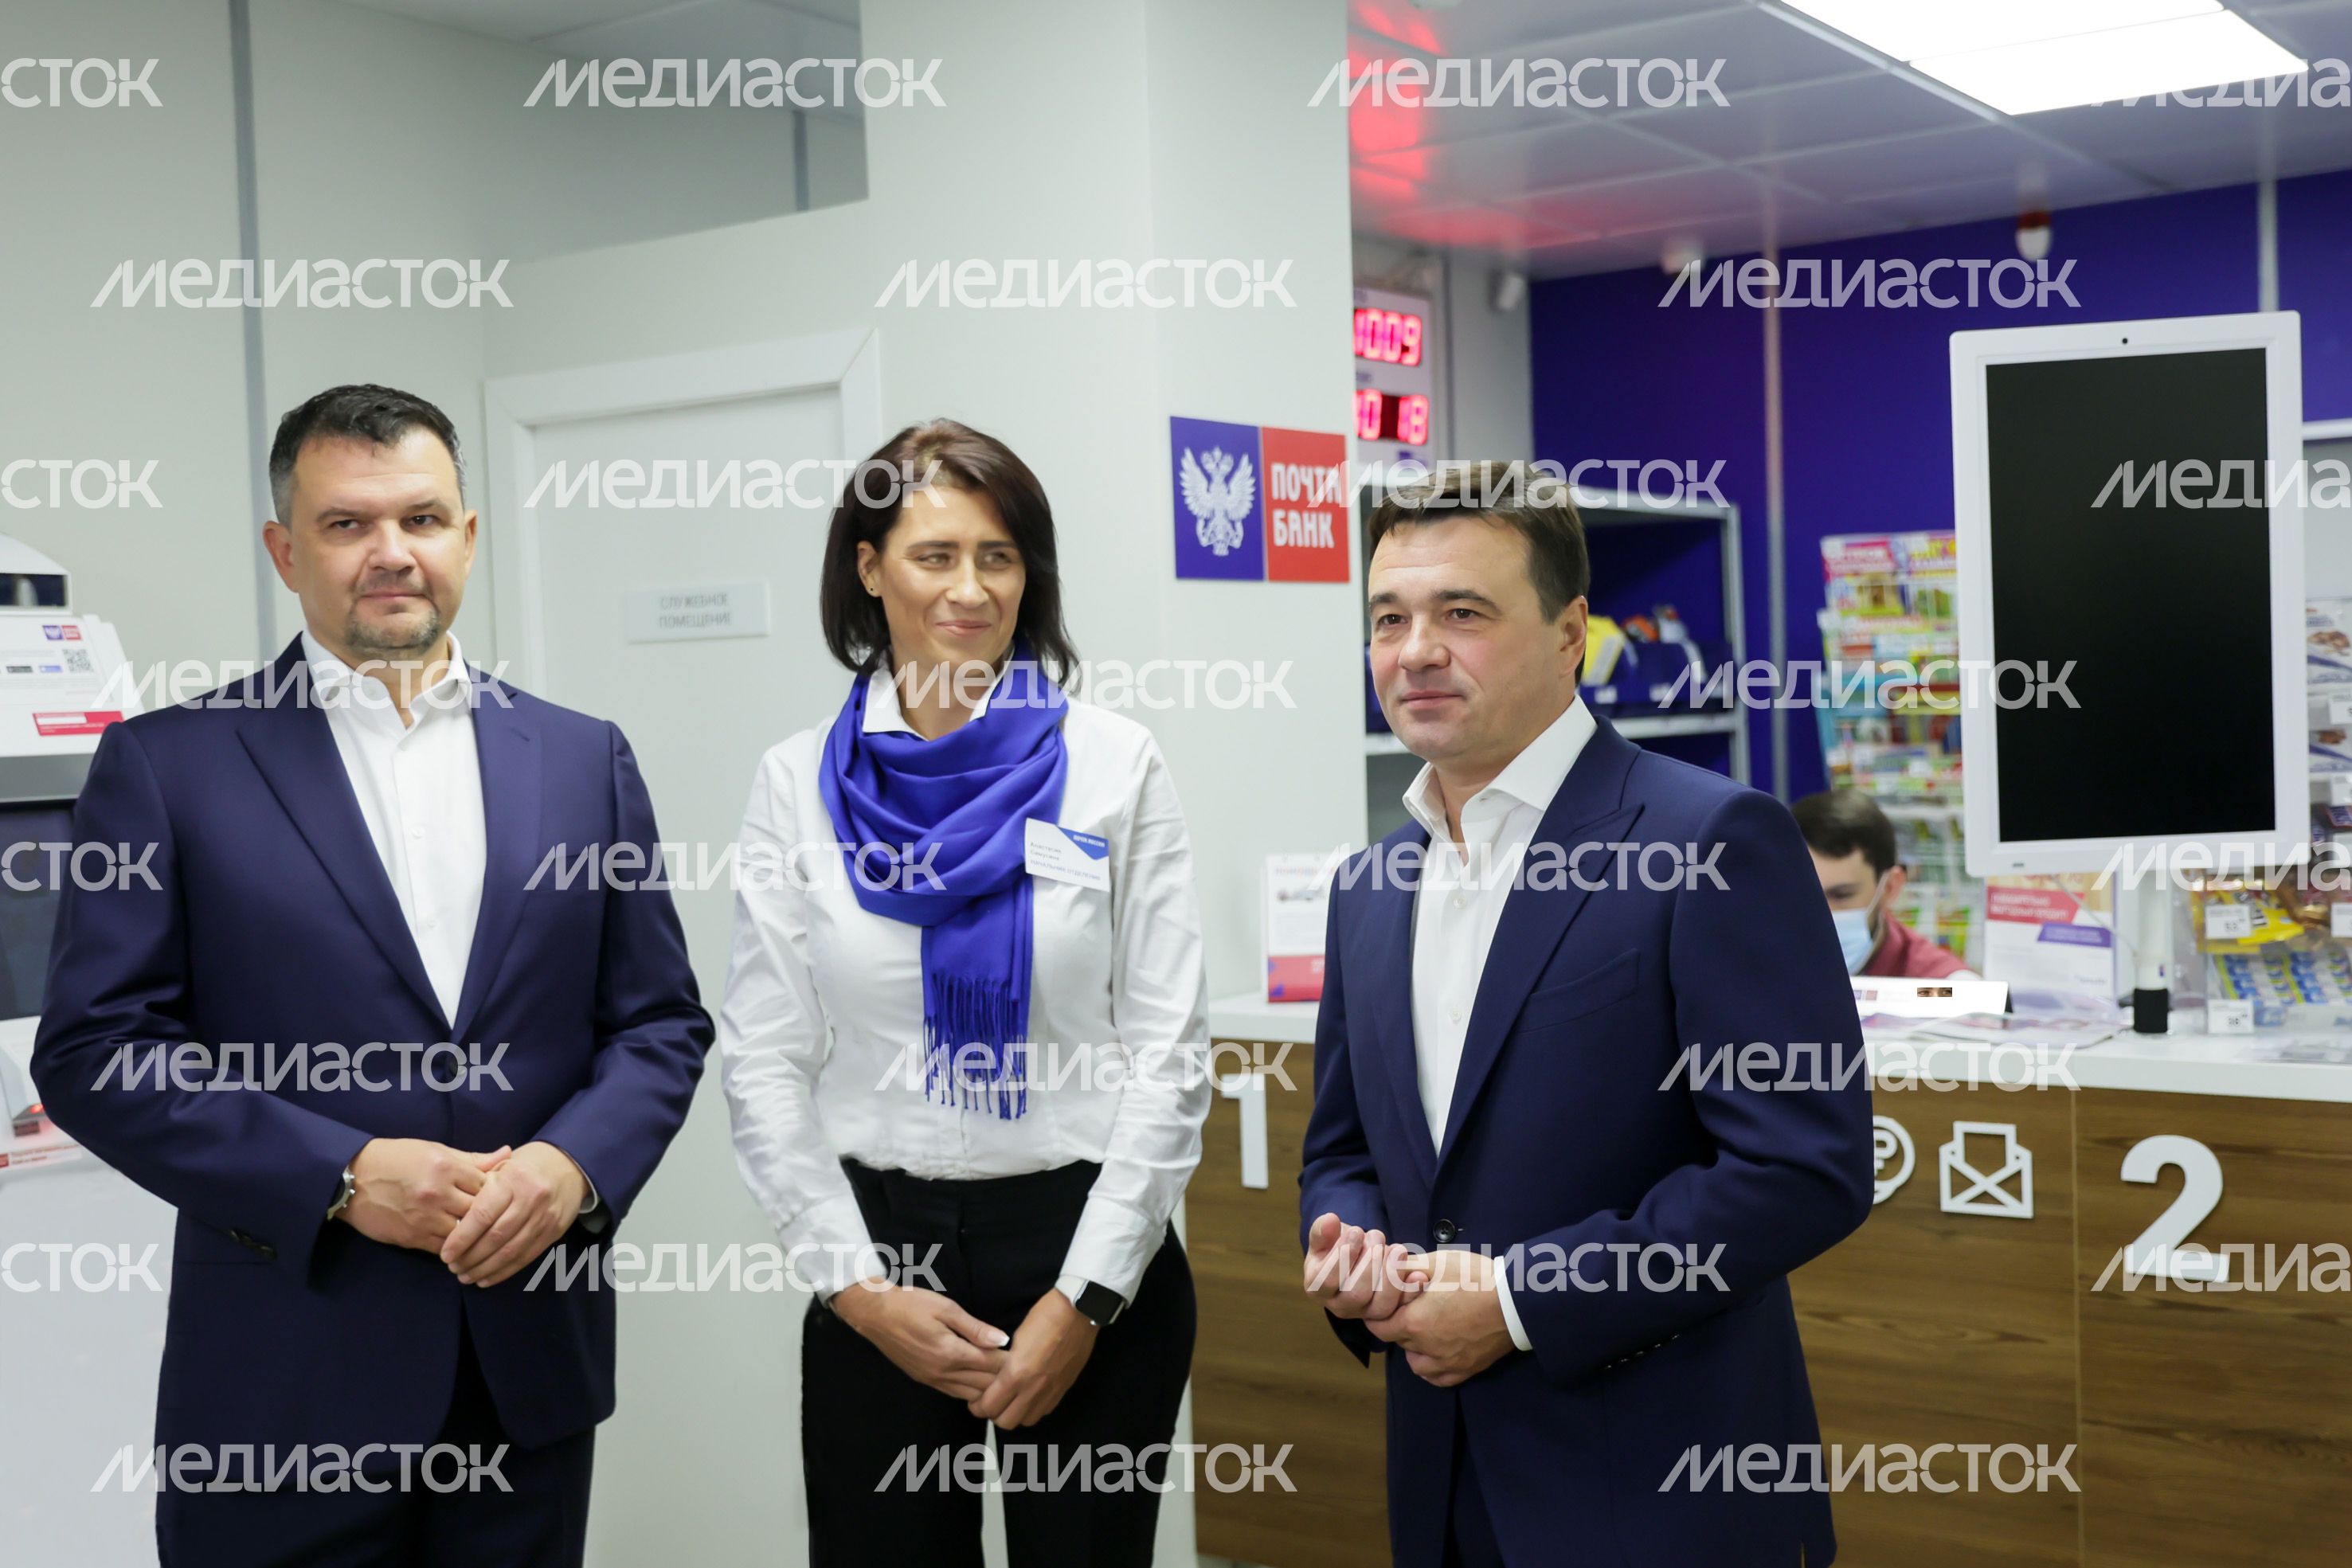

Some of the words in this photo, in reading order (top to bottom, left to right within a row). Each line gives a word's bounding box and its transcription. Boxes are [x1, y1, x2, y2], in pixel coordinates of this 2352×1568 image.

[1271, 462, 1340, 505] ПОЧТА
[1273, 509, 1335, 548] БАНК
[659, 612, 731, 629] ПОМЕЩЕНИЕ
[1221, 1073, 1269, 1189] 1
[2120, 1135, 2230, 1283] 2
